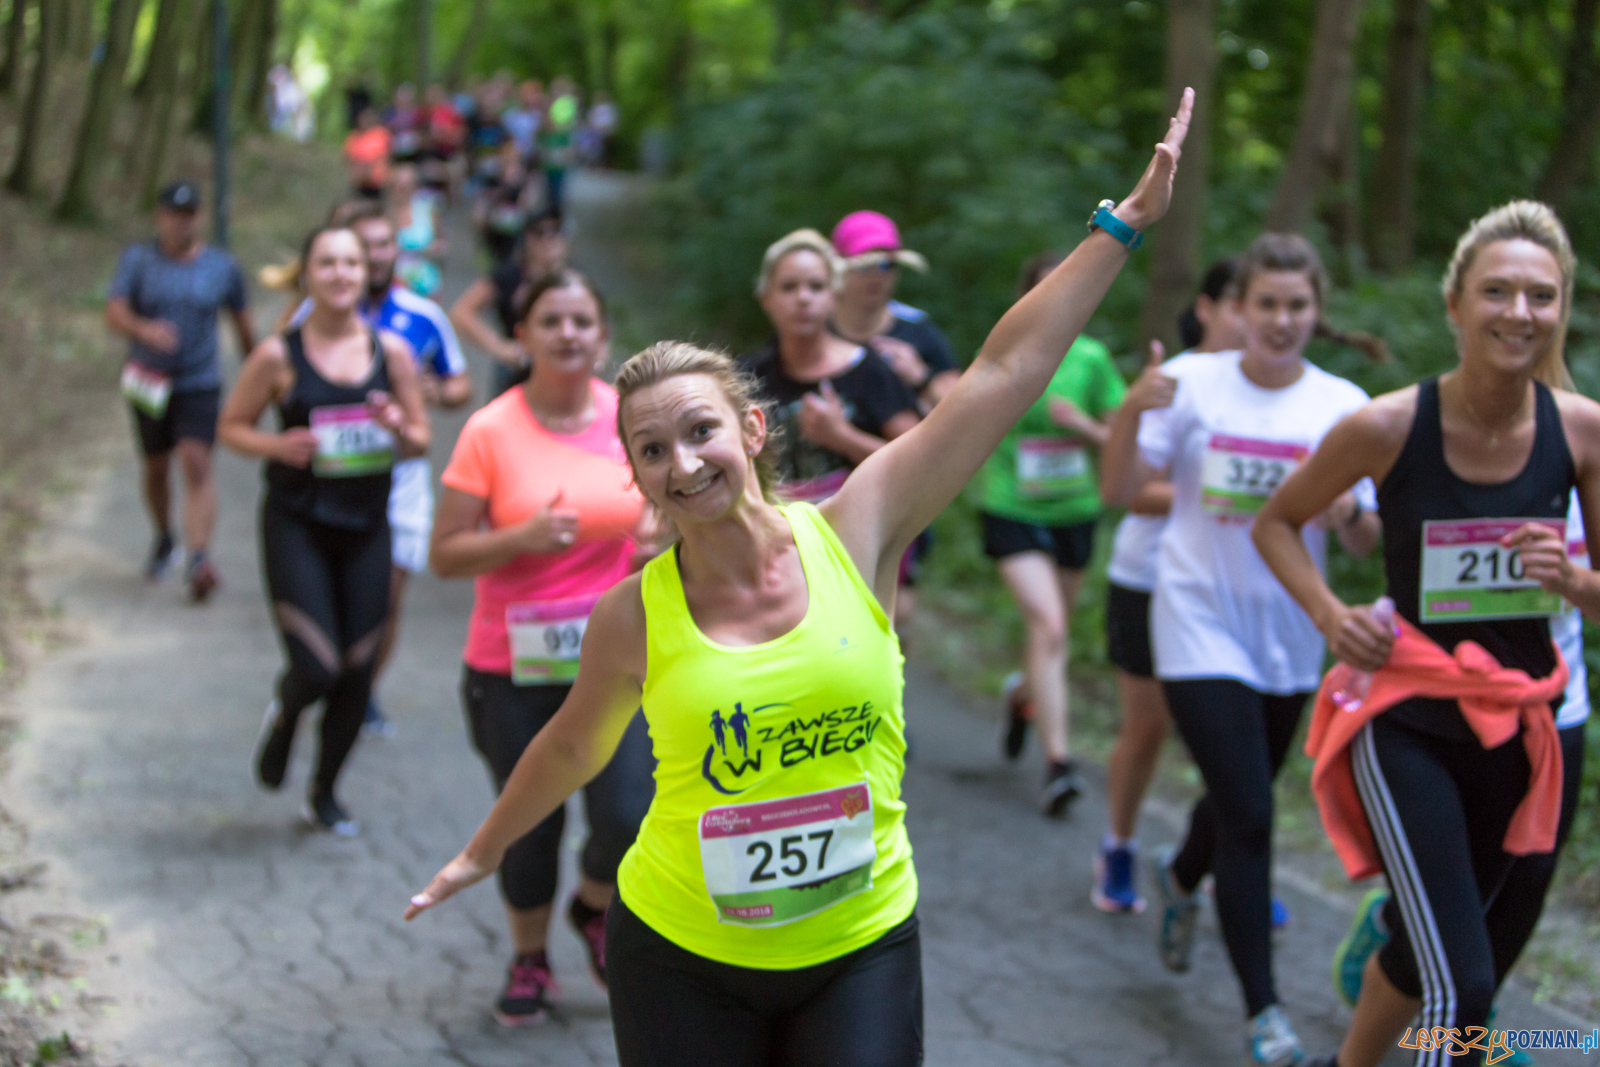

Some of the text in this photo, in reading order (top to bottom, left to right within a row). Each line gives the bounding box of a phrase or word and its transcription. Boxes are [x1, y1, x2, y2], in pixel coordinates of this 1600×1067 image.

[1227, 457, 1286, 488] 322
[1457, 549, 1525, 582] 210
[756, 701, 874, 743] ZAWSZE
[722, 716, 882, 778] W BIEGU
[746, 829, 834, 883] 257
